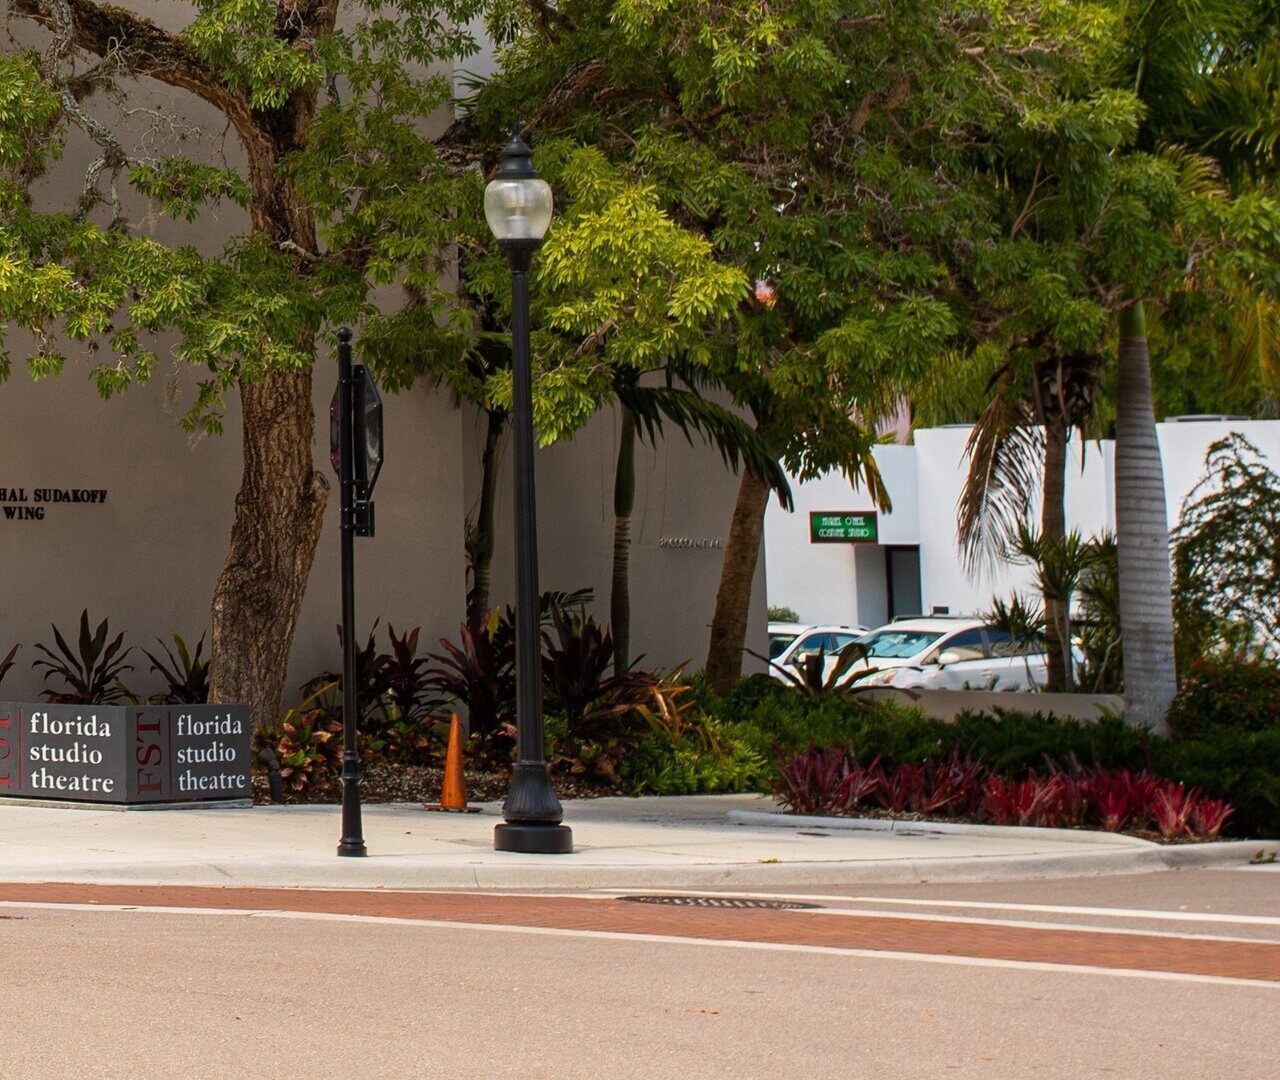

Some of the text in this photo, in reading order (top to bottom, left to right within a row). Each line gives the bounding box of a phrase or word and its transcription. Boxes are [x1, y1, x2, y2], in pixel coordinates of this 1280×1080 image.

[34, 489, 108, 503] SUDAKOFF
[3, 506, 45, 520] WING
[30, 712, 112, 737] florida
[176, 713, 242, 736] florida
[29, 742, 103, 764] studio
[135, 711, 162, 795] FST
[176, 742, 236, 764] studio
[30, 767, 114, 793] theatre
[178, 769, 246, 792] theatre
